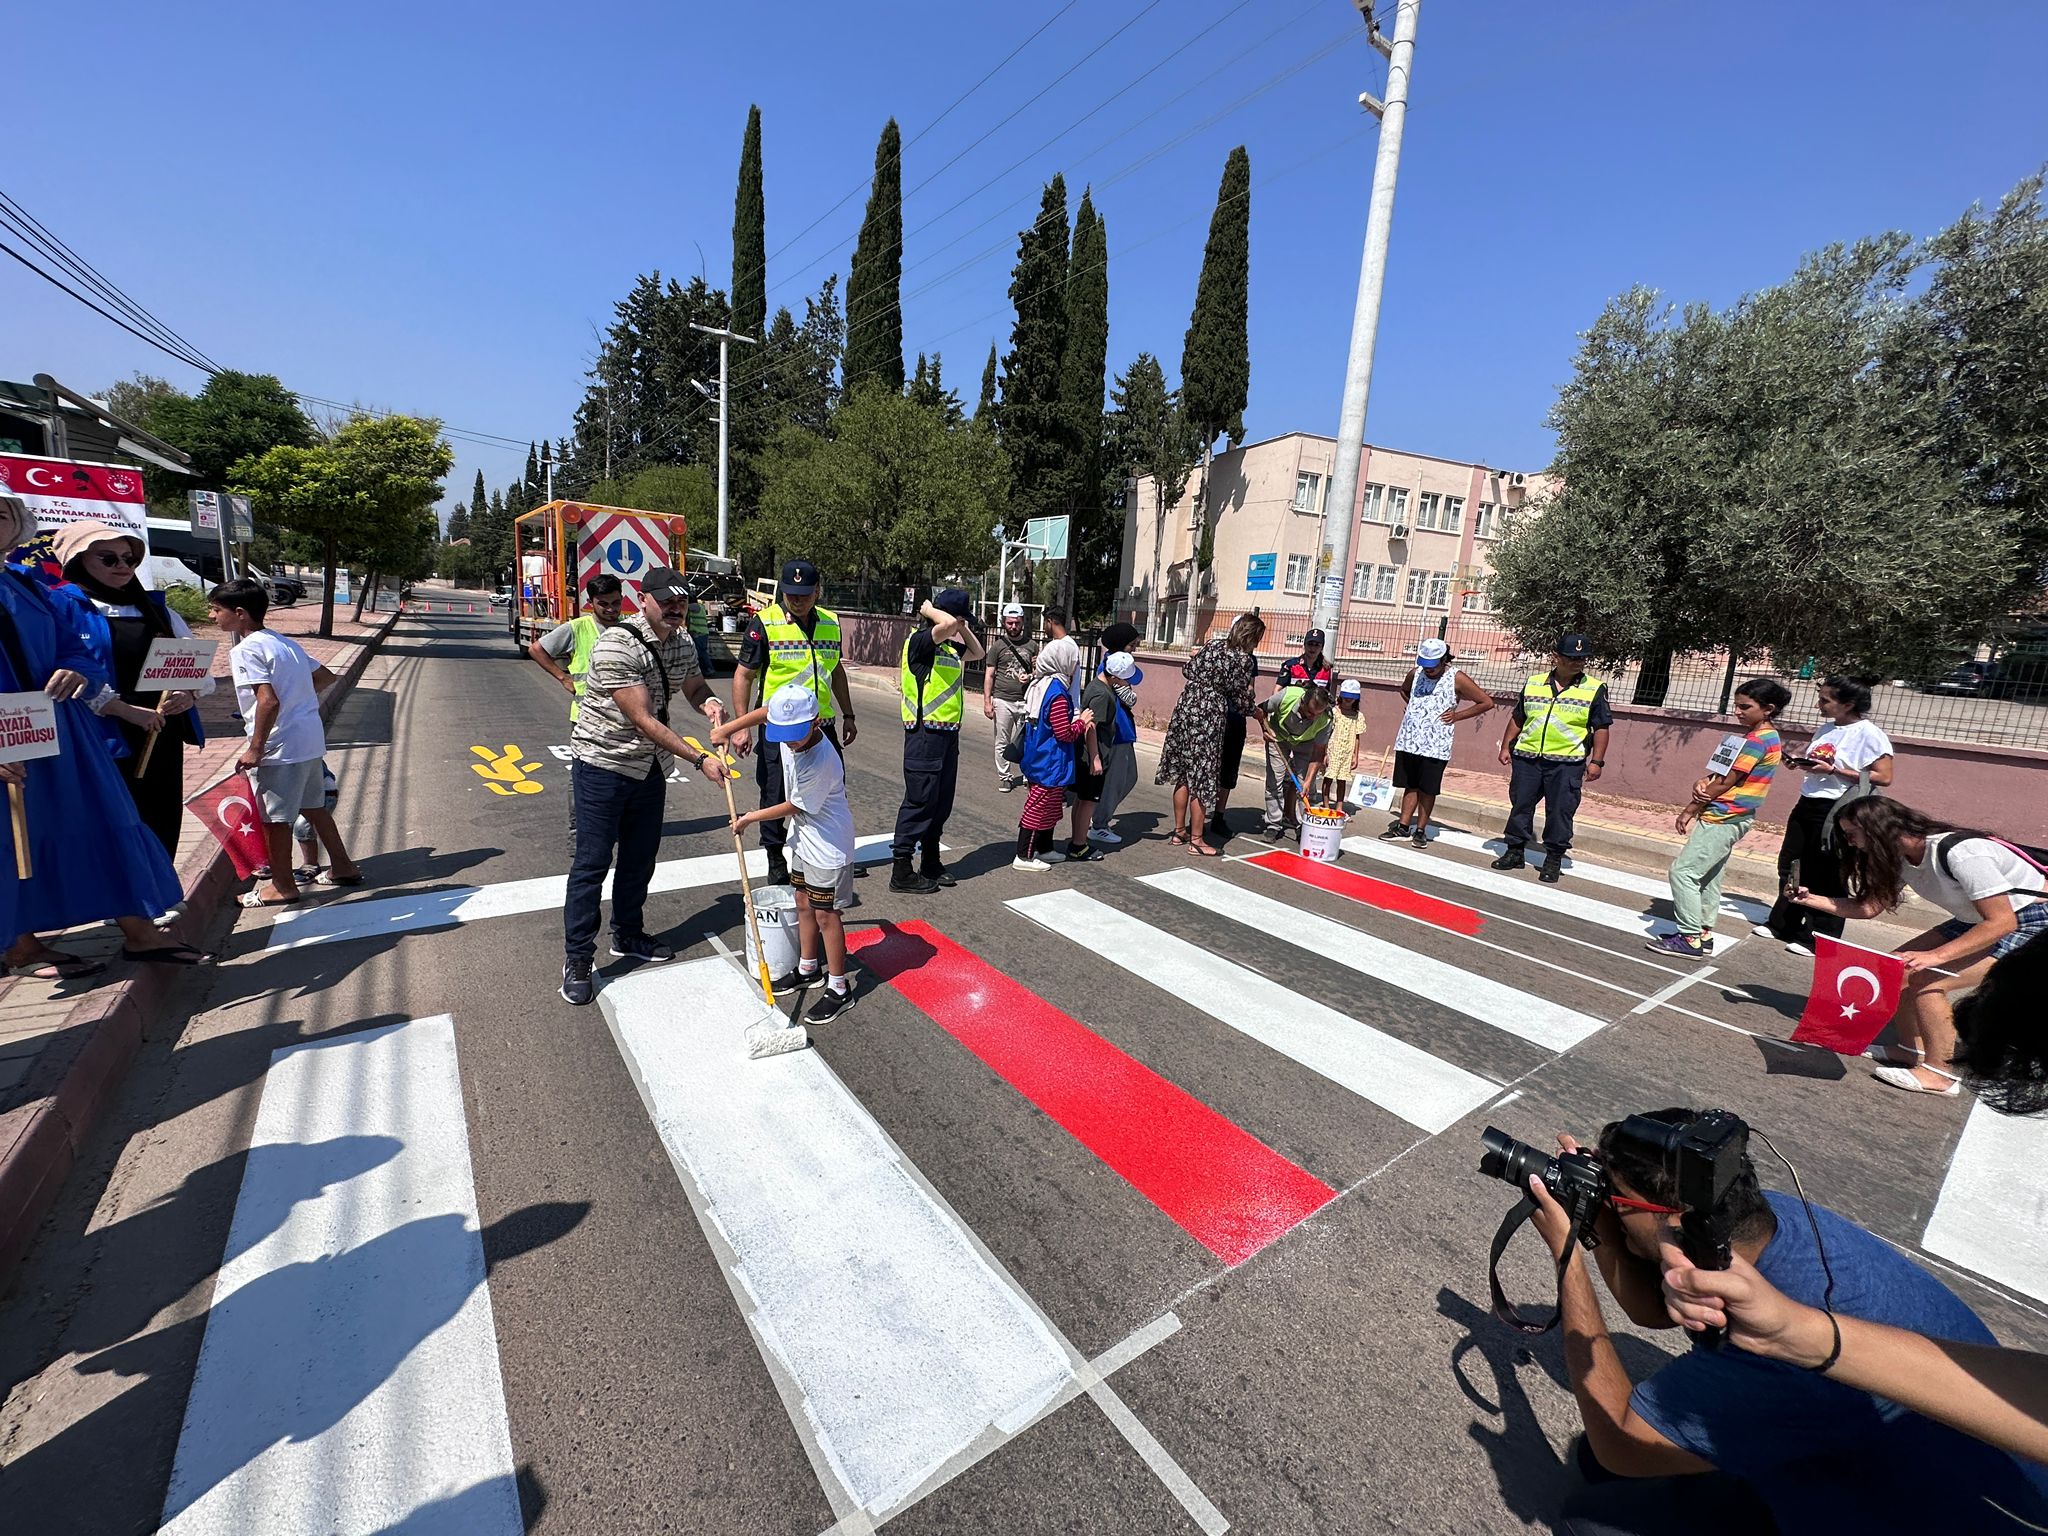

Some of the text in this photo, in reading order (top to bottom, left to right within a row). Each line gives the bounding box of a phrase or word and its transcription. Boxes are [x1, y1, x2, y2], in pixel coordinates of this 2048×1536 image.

[41, 508, 121, 519] KAYMAKAMLIĞI
[35, 516, 68, 524] ARMA
[163, 657, 195, 667] HAYATA
[143, 667, 208, 679] SAYGI DURUŞU
[0, 716, 33, 733] AYATA
[7, 727, 55, 747] DURUŞU
[1306, 815, 1337, 826] KISAN
[756, 910, 778, 923] AN
